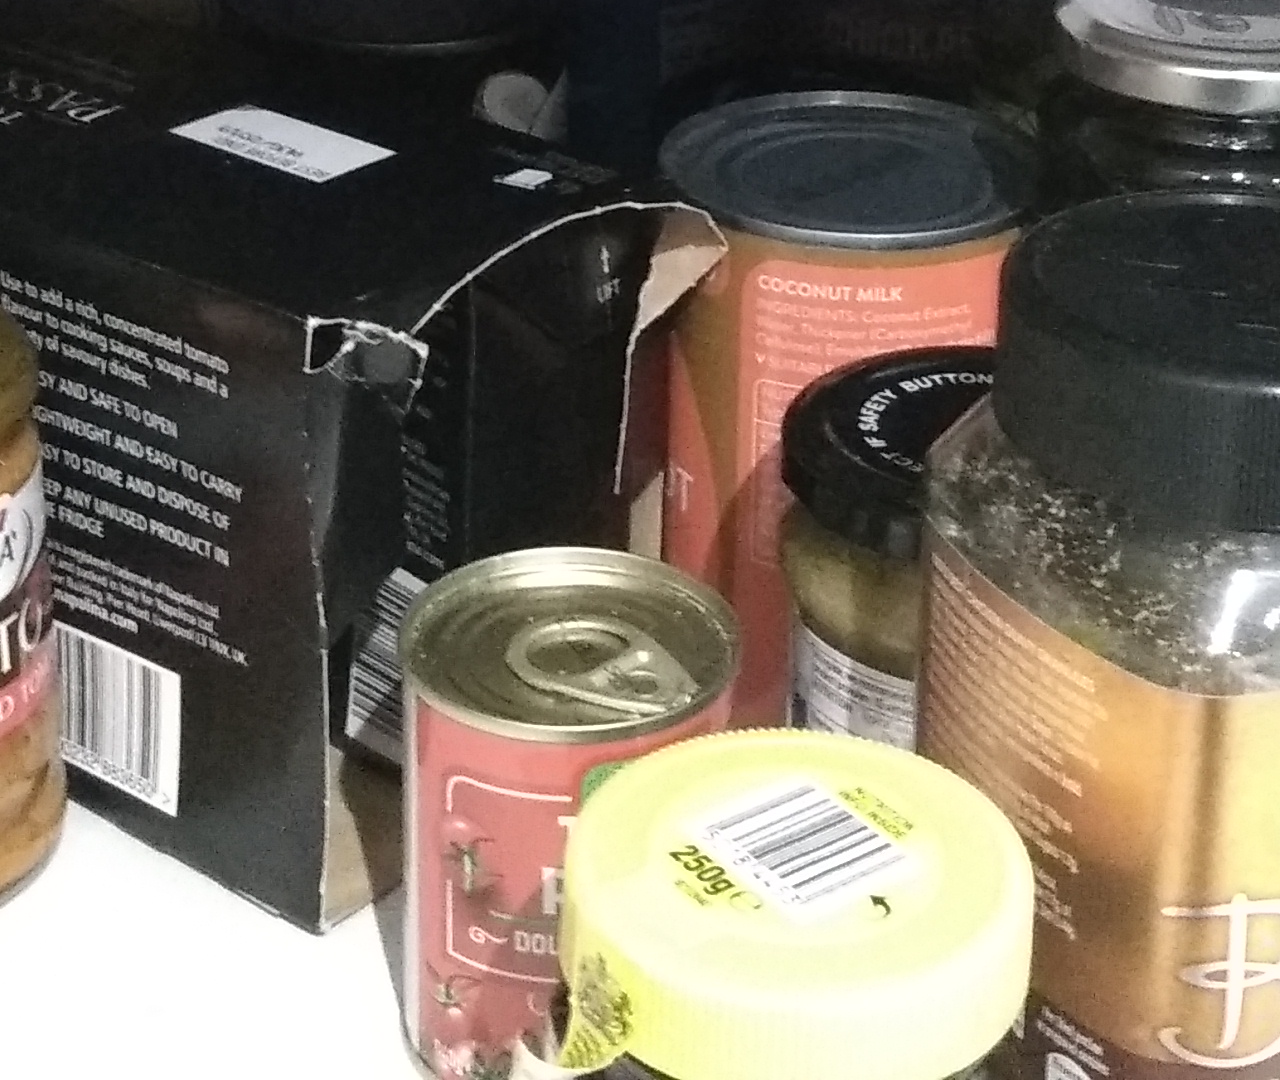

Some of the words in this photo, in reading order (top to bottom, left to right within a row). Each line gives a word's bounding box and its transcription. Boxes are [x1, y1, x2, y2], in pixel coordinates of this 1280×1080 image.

[0, 269, 23, 294] Use
[24, 281, 39, 299] to
[40, 286, 64, 309] add
[64, 296, 74, 313] a
[103, 312, 184, 356] concentrated
[183, 341, 231, 375] tomato
[757, 274, 852, 303] COCONUT
[855, 286, 904, 303] MILK
[44, 334, 60, 353] of
[60, 341, 109, 376] savoury
[44, 311, 59, 330] to
[59, 318, 108, 354] cooking
[154, 355, 192, 384] soups
[192, 371, 218, 395] and
[218, 382, 230, 400] a
[37, 370, 58, 391] SY
[58, 376, 89, 403] AND
[88, 387, 123, 416] SAFE
[123, 401, 142, 423] TO
[142, 409, 180, 440] OPEN
[857, 387, 899, 434] SAFETY
[897, 372, 995, 394] BUTTON
[41, 442, 62, 462] SY
[62, 448, 83, 471] TO
[81, 456, 125, 490] STORE
[124, 474, 157, 500] AND
[156, 483, 213, 525] DISPOSE
[211, 510, 232, 532] OF
[113, 433, 146, 460] AND
[145, 444, 181, 474] EASY
[180, 459, 201, 484] TO
[200, 468, 245, 504] CARRY
[41, 476, 63, 499] EEP
[62, 484, 94, 511] ANY
[93, 496, 149, 534] UNUSED
[148, 517, 213, 560] PRODUCT
[213, 544, 232, 567] IN
[57, 502, 106, 540] FRIDGE
[668, 843, 737, 897] 250g
